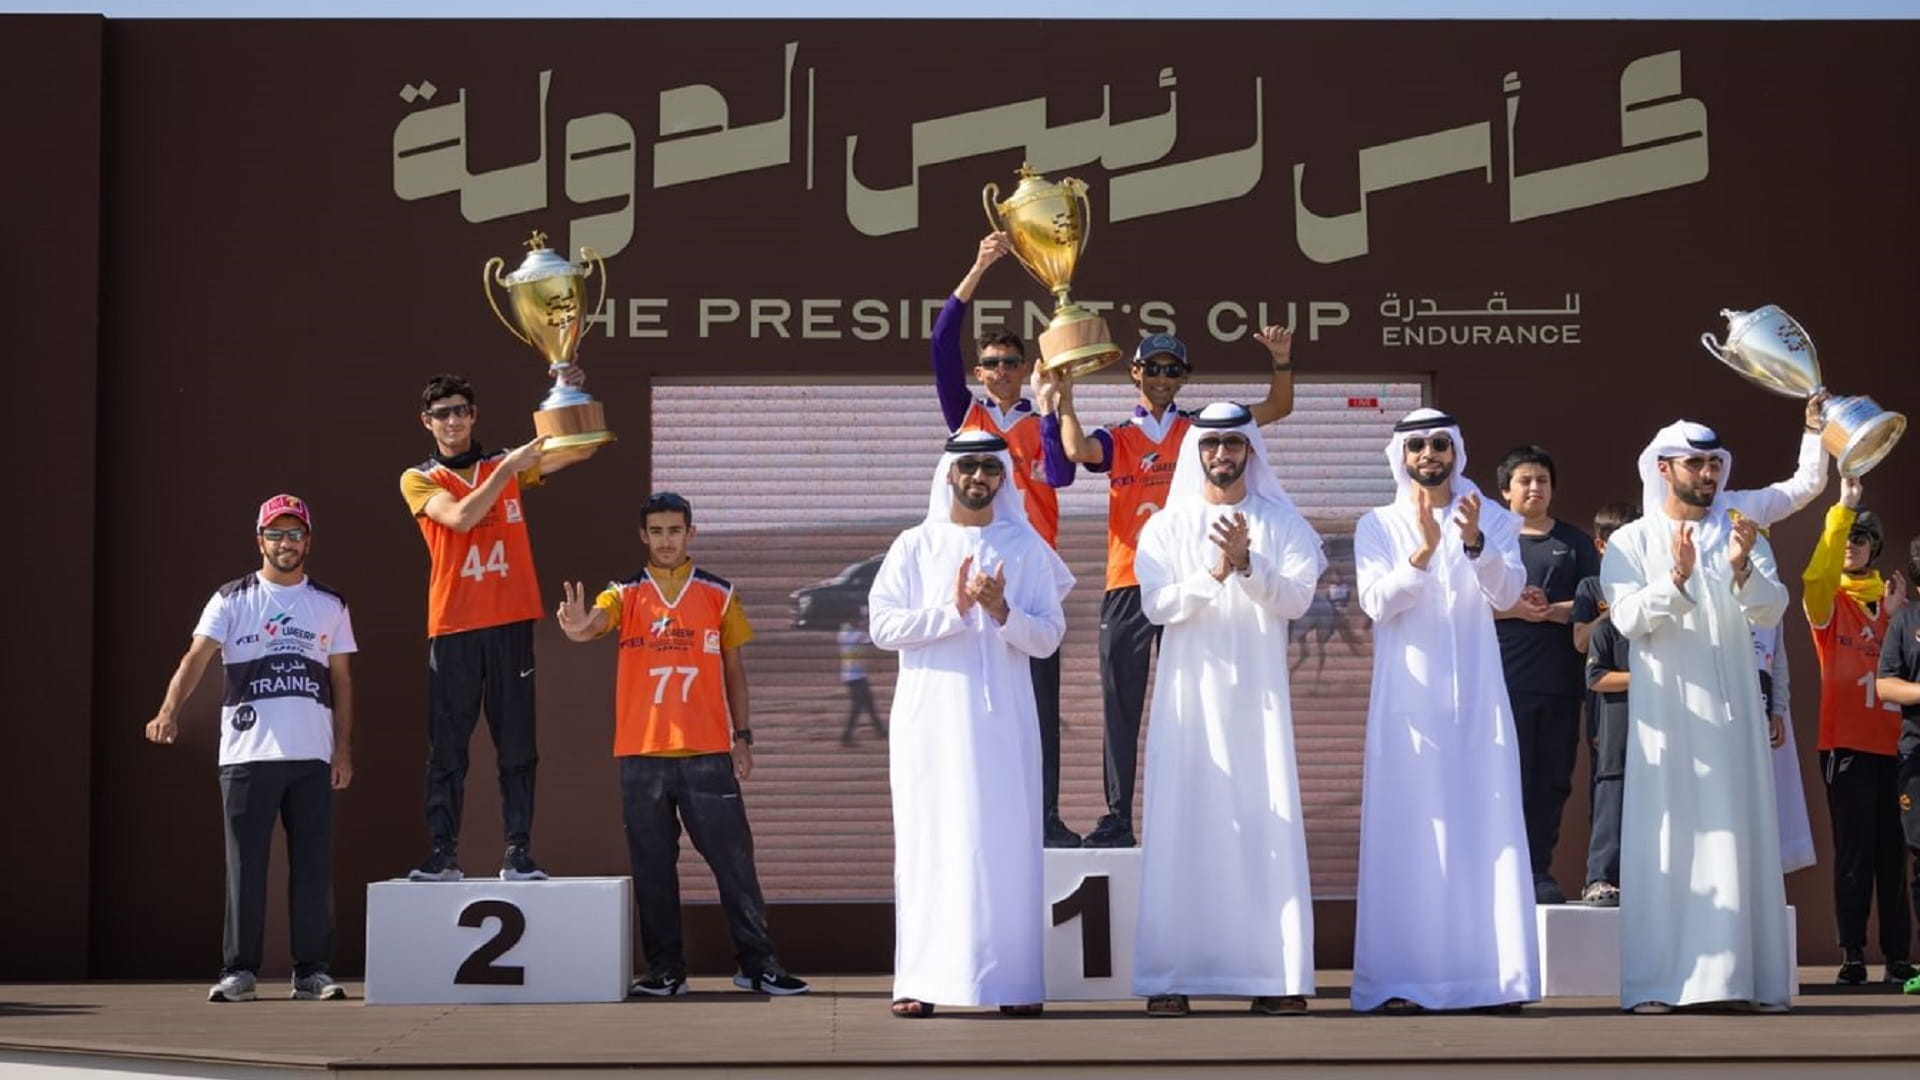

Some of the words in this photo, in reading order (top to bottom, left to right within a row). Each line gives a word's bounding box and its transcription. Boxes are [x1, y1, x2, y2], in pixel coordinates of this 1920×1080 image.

[393, 41, 816, 262] الدولة
[846, 66, 1263, 237] رئيس
[1293, 49, 1709, 265] كأس
[584, 298, 669, 338] HE
[1207, 301, 1351, 342] CUP
[1382, 324, 1582, 347] ENDURANCE
[460, 539, 510, 582] 44
[649, 665, 700, 705] 77
[1856, 671, 1902, 712] 1
[453, 899, 527, 986] 2
[1051, 875, 1113, 979] 1
